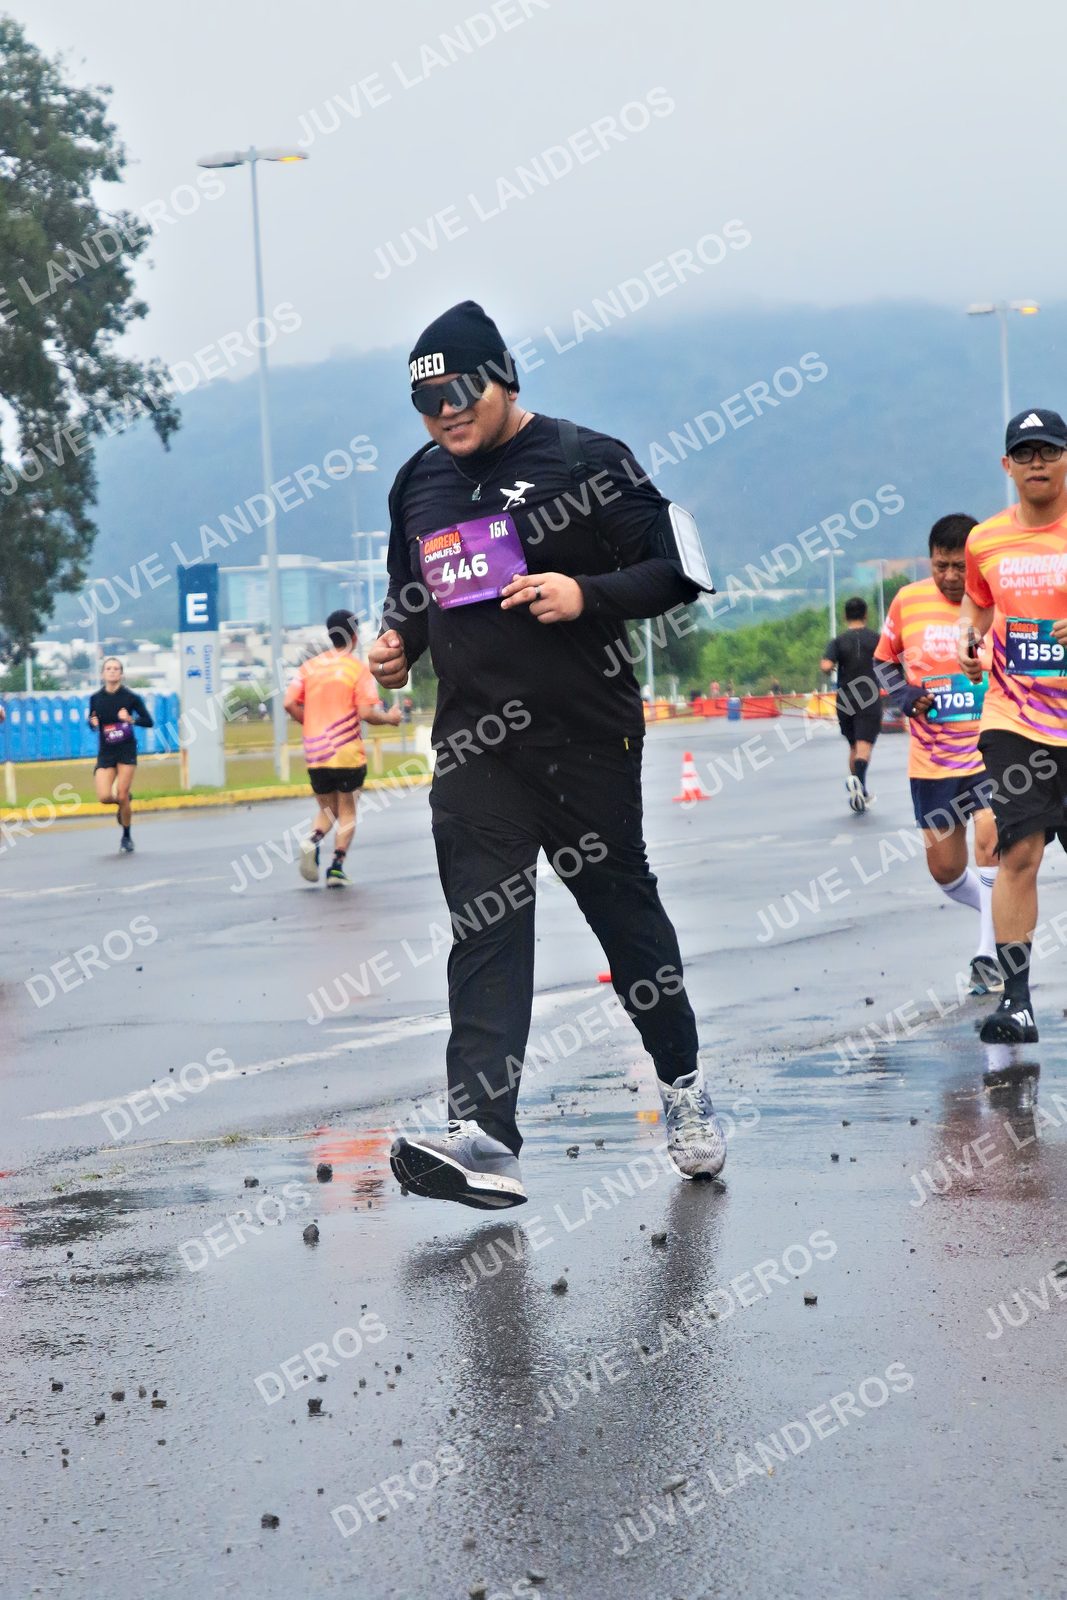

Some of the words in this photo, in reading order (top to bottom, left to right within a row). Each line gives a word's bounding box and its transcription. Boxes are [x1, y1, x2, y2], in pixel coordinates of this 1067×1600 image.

[488, 520, 508, 539] 16K
[424, 531, 460, 554] CARRERA
[442, 553, 488, 584] 446
[186, 592, 209, 624] E
[1018, 642, 1064, 661] 1359
[934, 692, 974, 710] 1703
